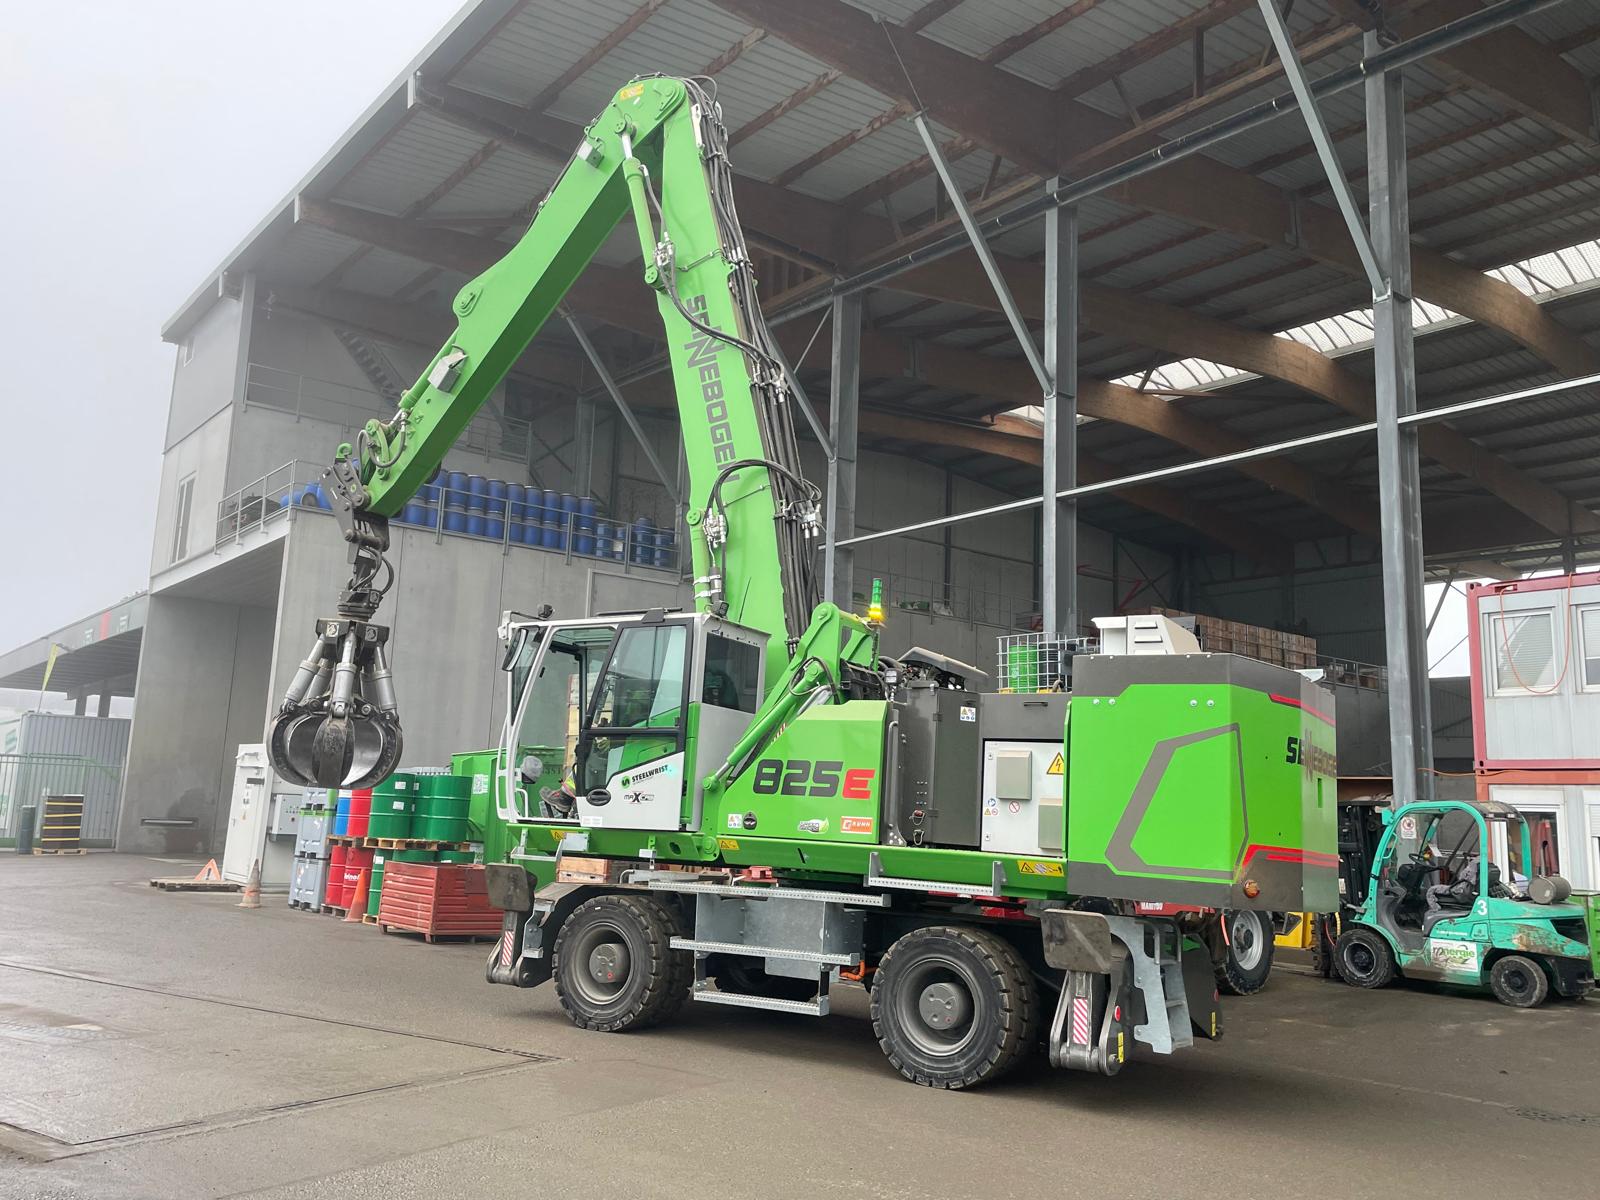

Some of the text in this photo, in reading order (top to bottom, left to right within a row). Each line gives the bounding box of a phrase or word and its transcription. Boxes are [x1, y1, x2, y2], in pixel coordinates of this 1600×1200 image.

[632, 764, 669, 783] STEELWRIST
[753, 759, 876, 799] 825E
[1477, 899, 1488, 916] 3
